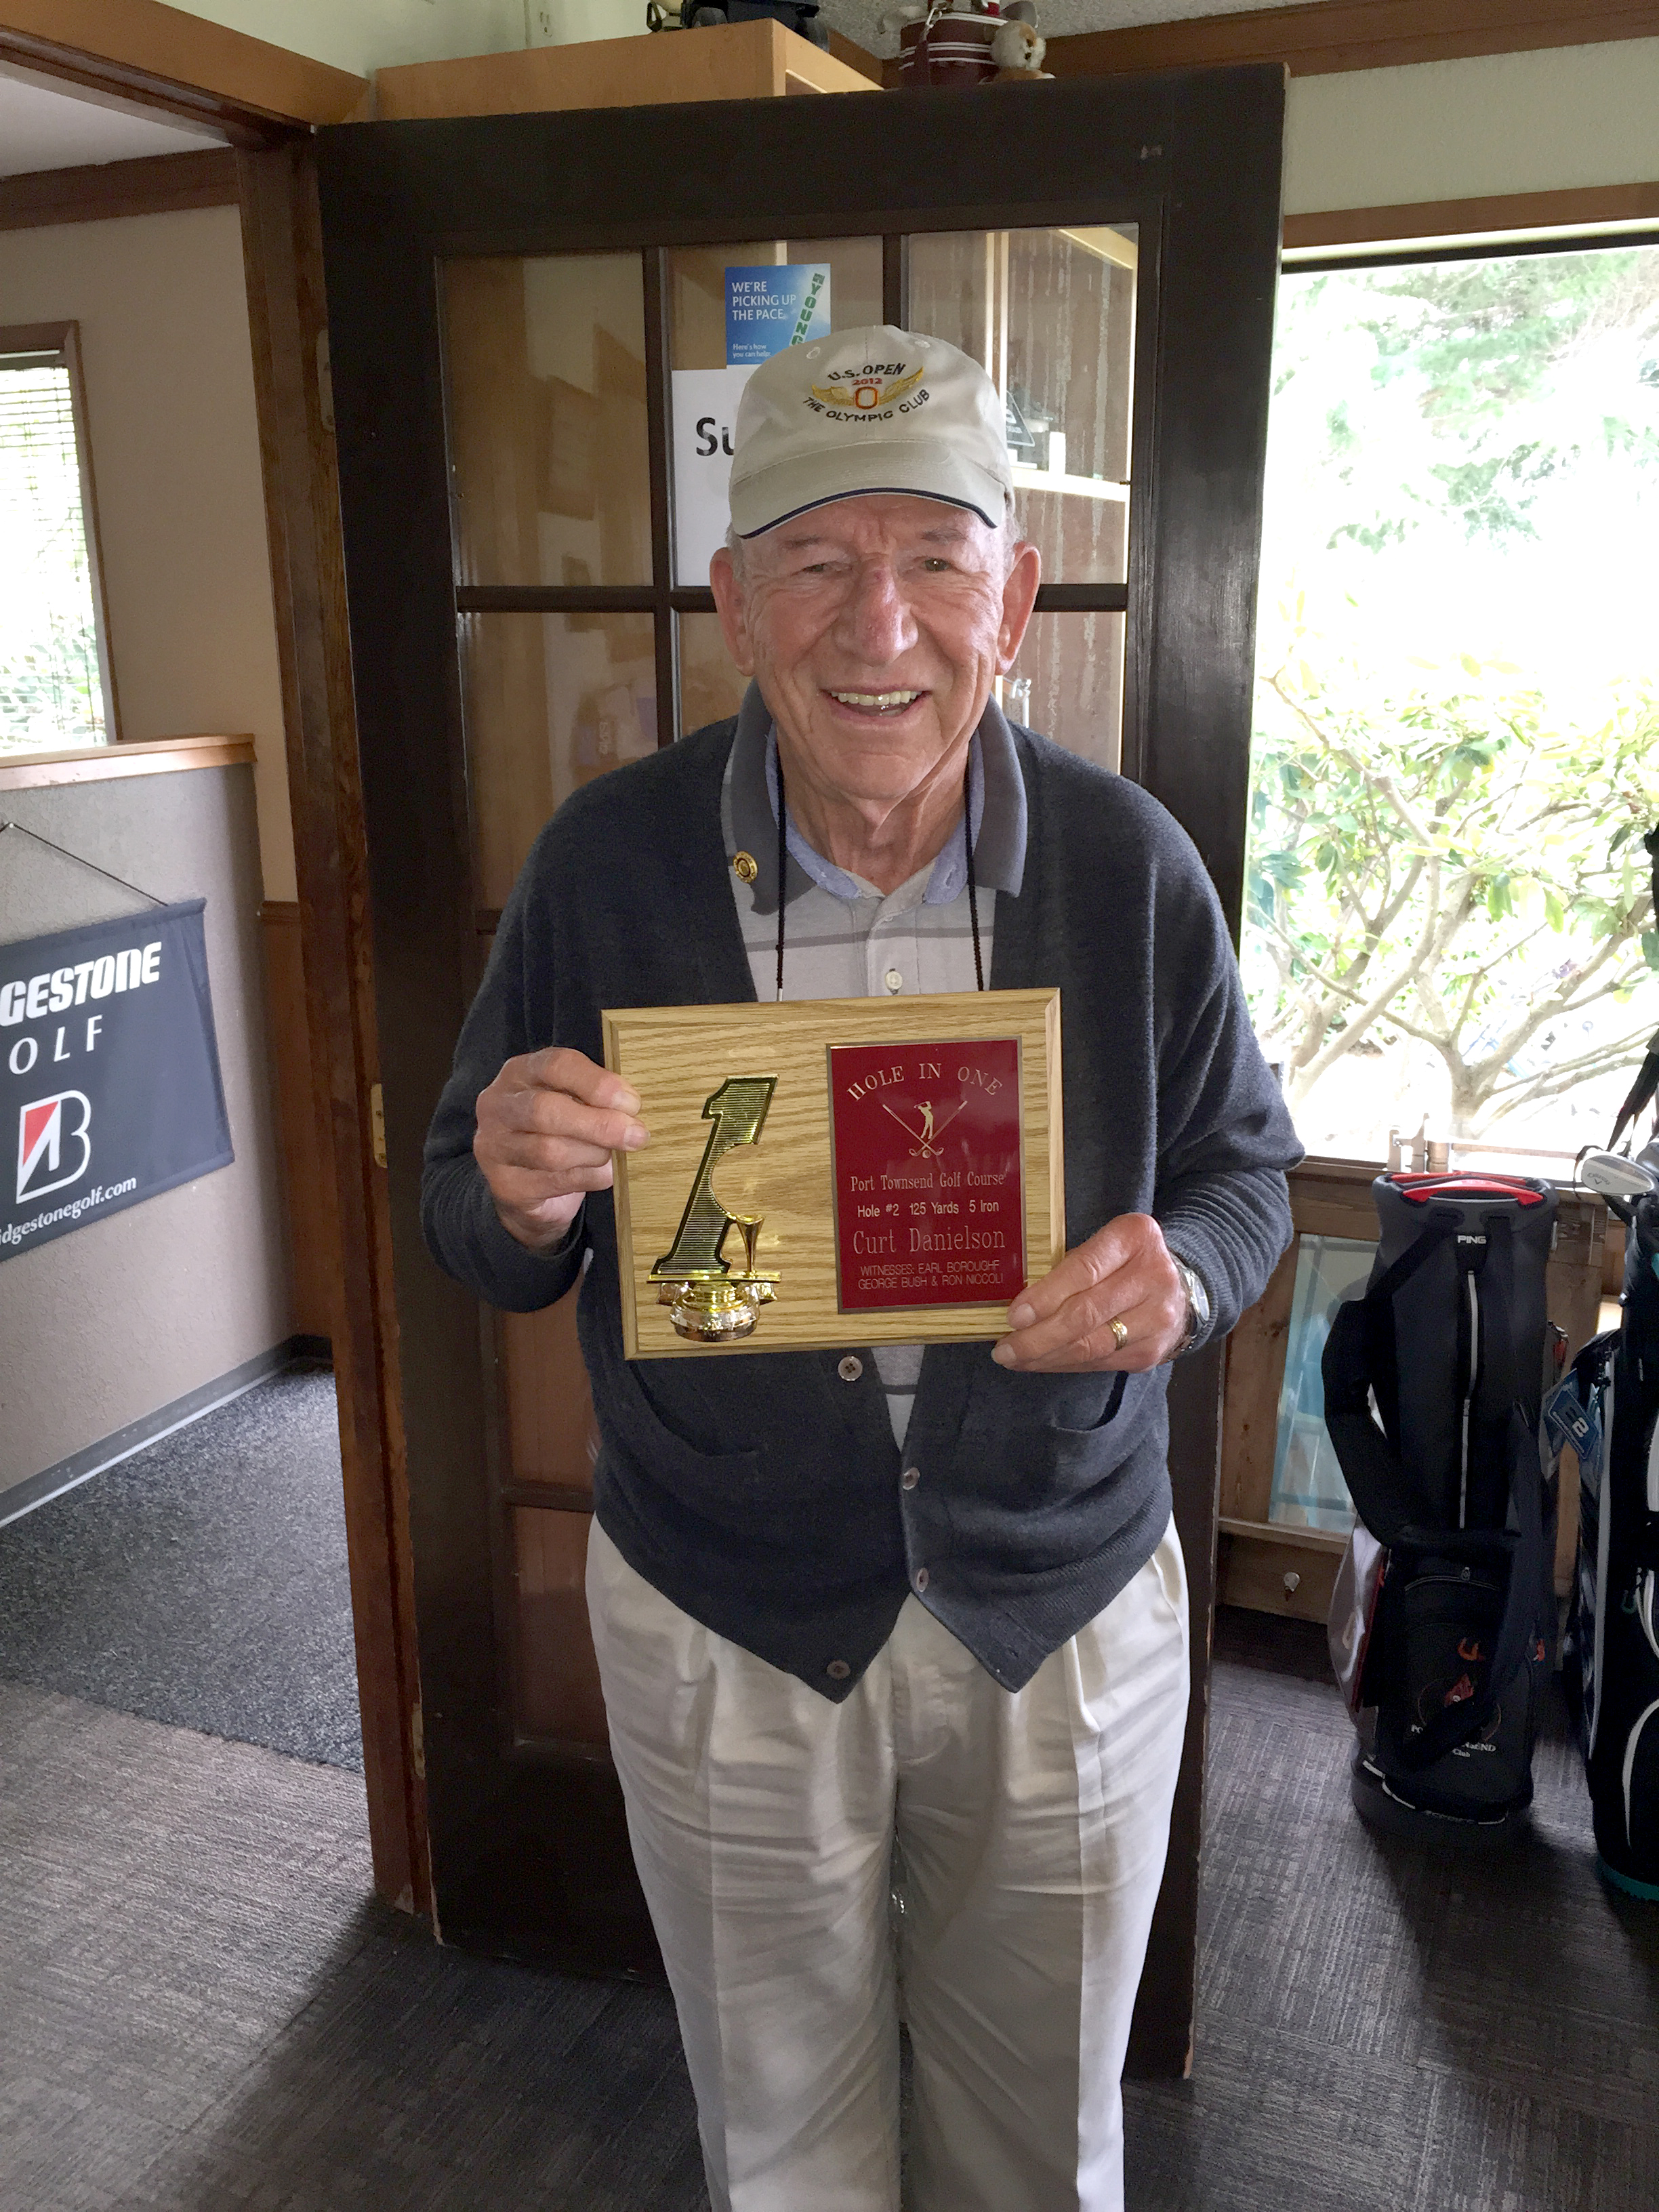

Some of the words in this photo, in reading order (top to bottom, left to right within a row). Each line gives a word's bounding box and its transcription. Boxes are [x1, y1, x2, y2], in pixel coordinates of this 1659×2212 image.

[732, 281, 767, 293] WE'RE
[733, 295, 779, 306] PICKING
[781, 294, 796, 305] UP
[733, 310, 754, 321] THE
[756, 309, 785, 320] PACE
[827, 369, 861, 381] U.S.
[863, 363, 906, 375] OPEN
[852, 377, 883, 386] 2012
[802, 396, 825, 413] THE
[826, 410, 893, 422] OLYMPIC
[899, 389, 930, 413] CLUB
[847, 1065, 904, 1101] HOLE
[919, 1063, 942, 1079] IN
[958, 1066, 1003, 1096] ONE
[851, 1175, 875, 1191] Port
[881, 1173, 933, 1190] Townsend
[939, 1171, 961, 1187] Golf
[967, 1171, 1005, 1186] Course
[857, 1204, 880, 1217] Hole
[885, 1204, 900, 1216] #2
[909, 1202, 926, 1215] 125
[931, 1201, 959, 1214] Yards
[968, 1200, 976, 1212] 5
[981, 1200, 1000, 1212] Iron
[853, 1228, 897, 1254] Curt
[909, 1225, 1006, 1252] Danielson
[1457, 1235, 1487, 1244] PING
[860, 1264, 915, 1276] WITNESSES:
[918, 1263, 943, 1274] EARL
[858, 1277, 897, 1290] GEORGE
[901, 1276, 927, 1287] BUSH
[931, 1276, 939, 1286] &
[942, 1275, 963, 1286] RON
